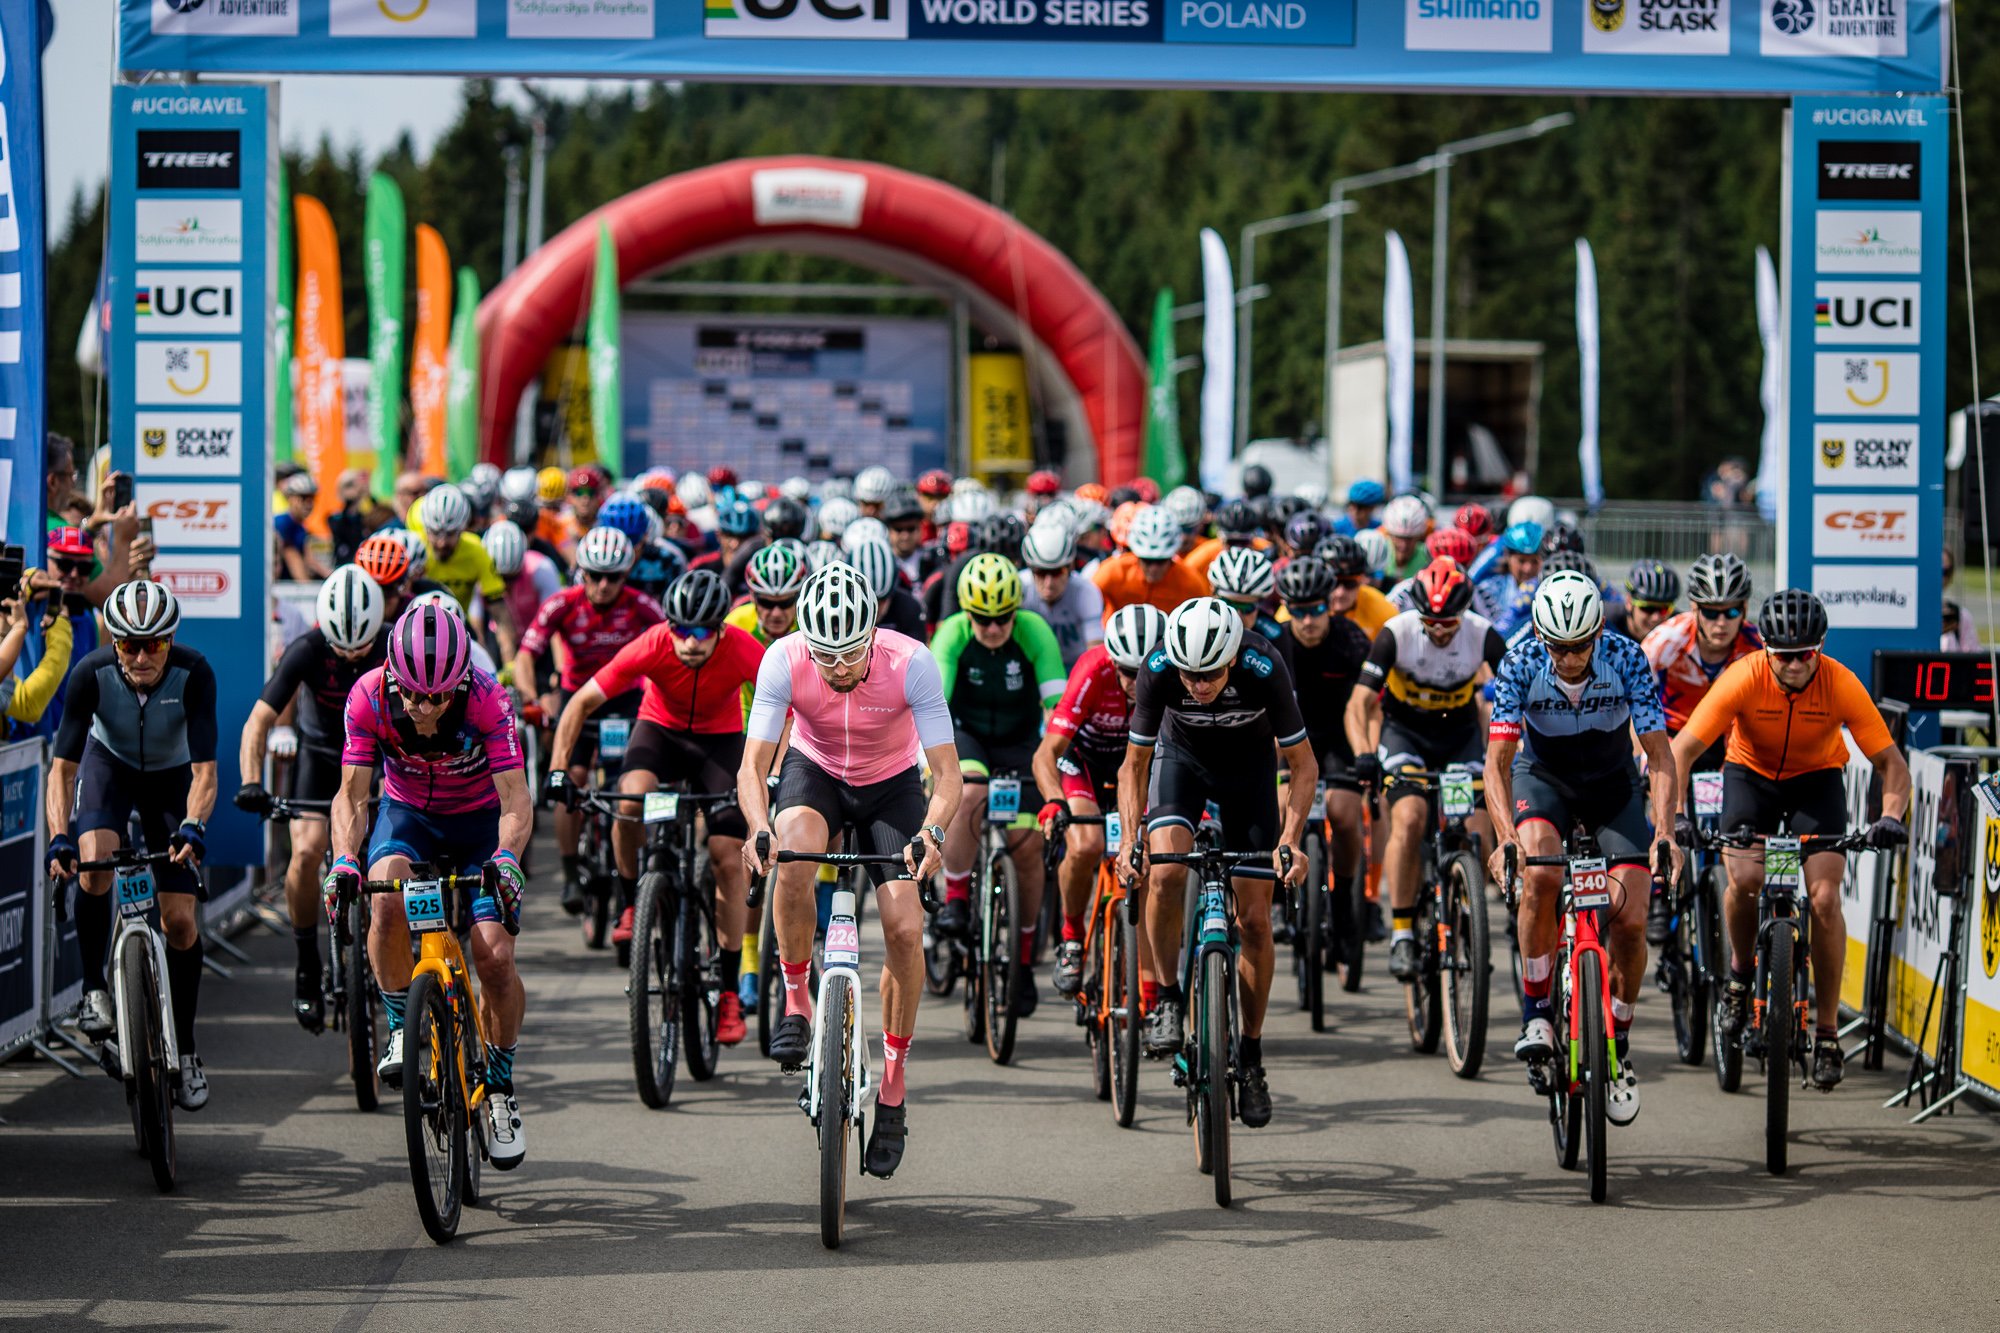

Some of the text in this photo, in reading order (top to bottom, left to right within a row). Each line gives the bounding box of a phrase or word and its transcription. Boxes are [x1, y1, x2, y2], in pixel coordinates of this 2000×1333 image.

[217, 0, 288, 17] ADVENTURE
[921, 1, 1149, 27] WORLD SERIES
[1180, 2, 1307, 29] POLAND
[1418, 0, 1541, 20] SHIMANO
[1828, 0, 1897, 16] GRAVEL
[1828, 19, 1897, 37] ADVENTURE
[131, 97, 247, 115] #UCIGRAVEL
[1812, 109, 1928, 126] #UCIGRAVEL
[144, 152, 233, 168] TREK
[1824, 163, 1914, 179] TREK
[155, 286, 232, 316] UCI
[1835, 298, 1912, 327] UCI
[176, 428, 234, 442] DOLNY
[1855, 439, 1912, 453] DOLNY
[147, 500, 229, 519] CST
[1824, 511, 1907, 530] CST
[1245, 654, 1271, 675] KMC
[1915, 662, 1951, 700] 10
[122, 880, 149, 898] 518
[1574, 873, 1607, 892] 540
[409, 898, 441, 916] 525
[828, 929, 857, 947] 226
